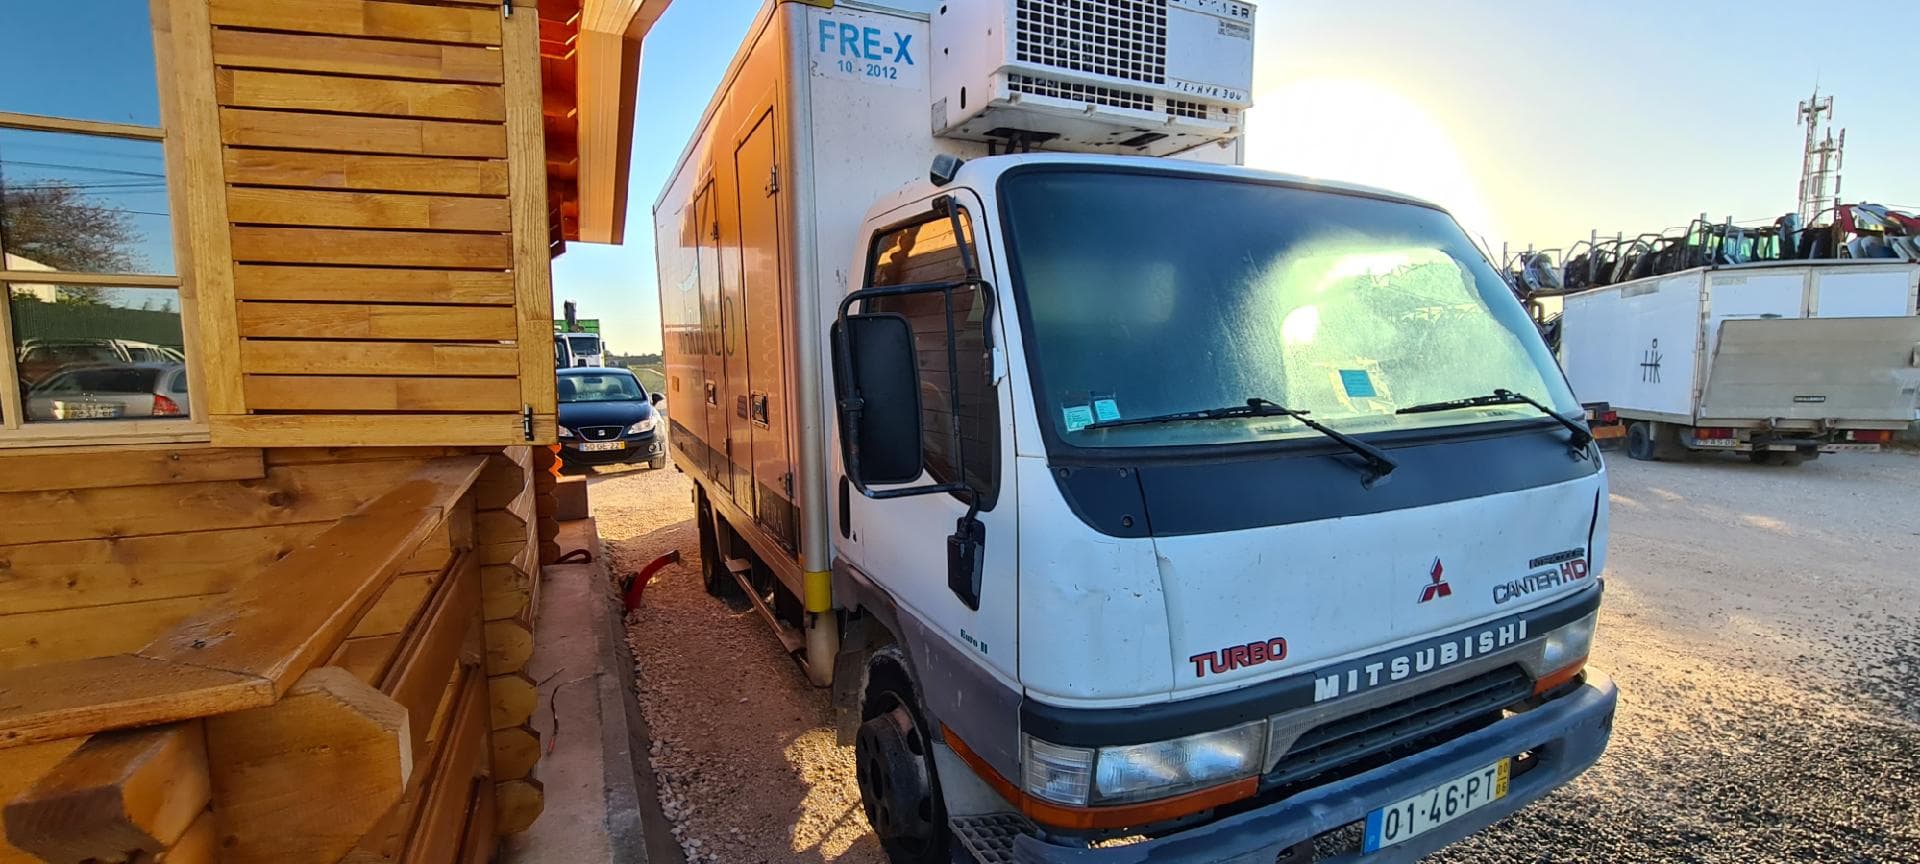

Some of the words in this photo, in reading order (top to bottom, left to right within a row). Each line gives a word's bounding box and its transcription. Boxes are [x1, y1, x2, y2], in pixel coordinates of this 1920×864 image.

[819, 19, 914, 65] FRE-X
[837, 60, 853, 73] 10
[866, 63, 897, 80] 2012
[1493, 568, 1561, 605] CANTER
[1560, 558, 1588, 584] HD
[960, 628, 978, 648] Euro
[1189, 637, 1288, 678] TURBO
[1314, 620, 1528, 702] MITSUBISHI
